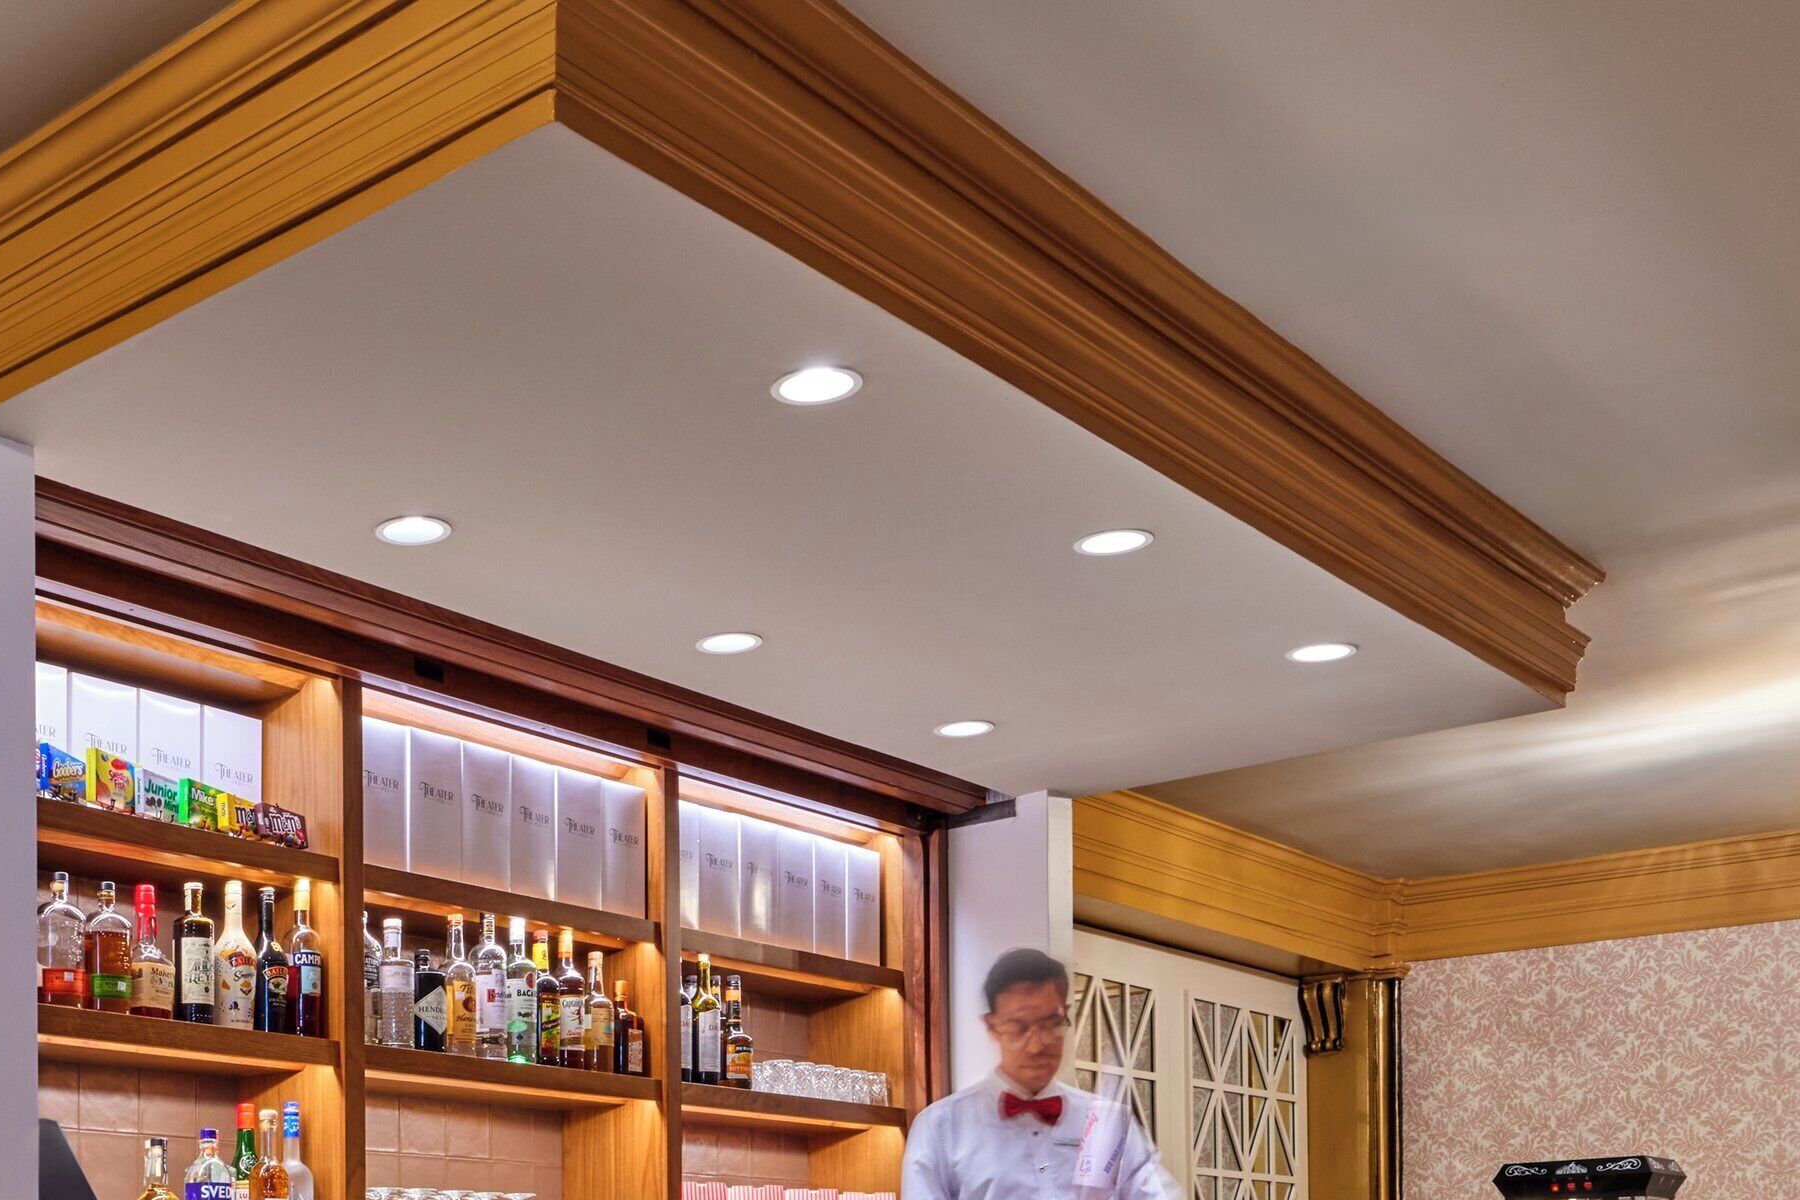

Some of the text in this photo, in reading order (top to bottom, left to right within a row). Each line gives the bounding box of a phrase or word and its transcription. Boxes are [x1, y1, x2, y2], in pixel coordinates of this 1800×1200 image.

[85, 732, 128, 754] THEATER
[151, 747, 192, 769] THEATER
[52, 758, 83, 779] Goobers
[215, 762, 255, 785] THEATER
[363, 769, 399, 790] THEATER
[144, 779, 177, 801] Junior
[191, 787, 214, 806] Mike
[419, 781, 454, 801] THEATER
[471, 793, 504, 813] THEATER
[519, 806, 550, 825] THEATER
[565, 817, 595, 836] THEATER
[609, 828, 639, 846] THEATER
